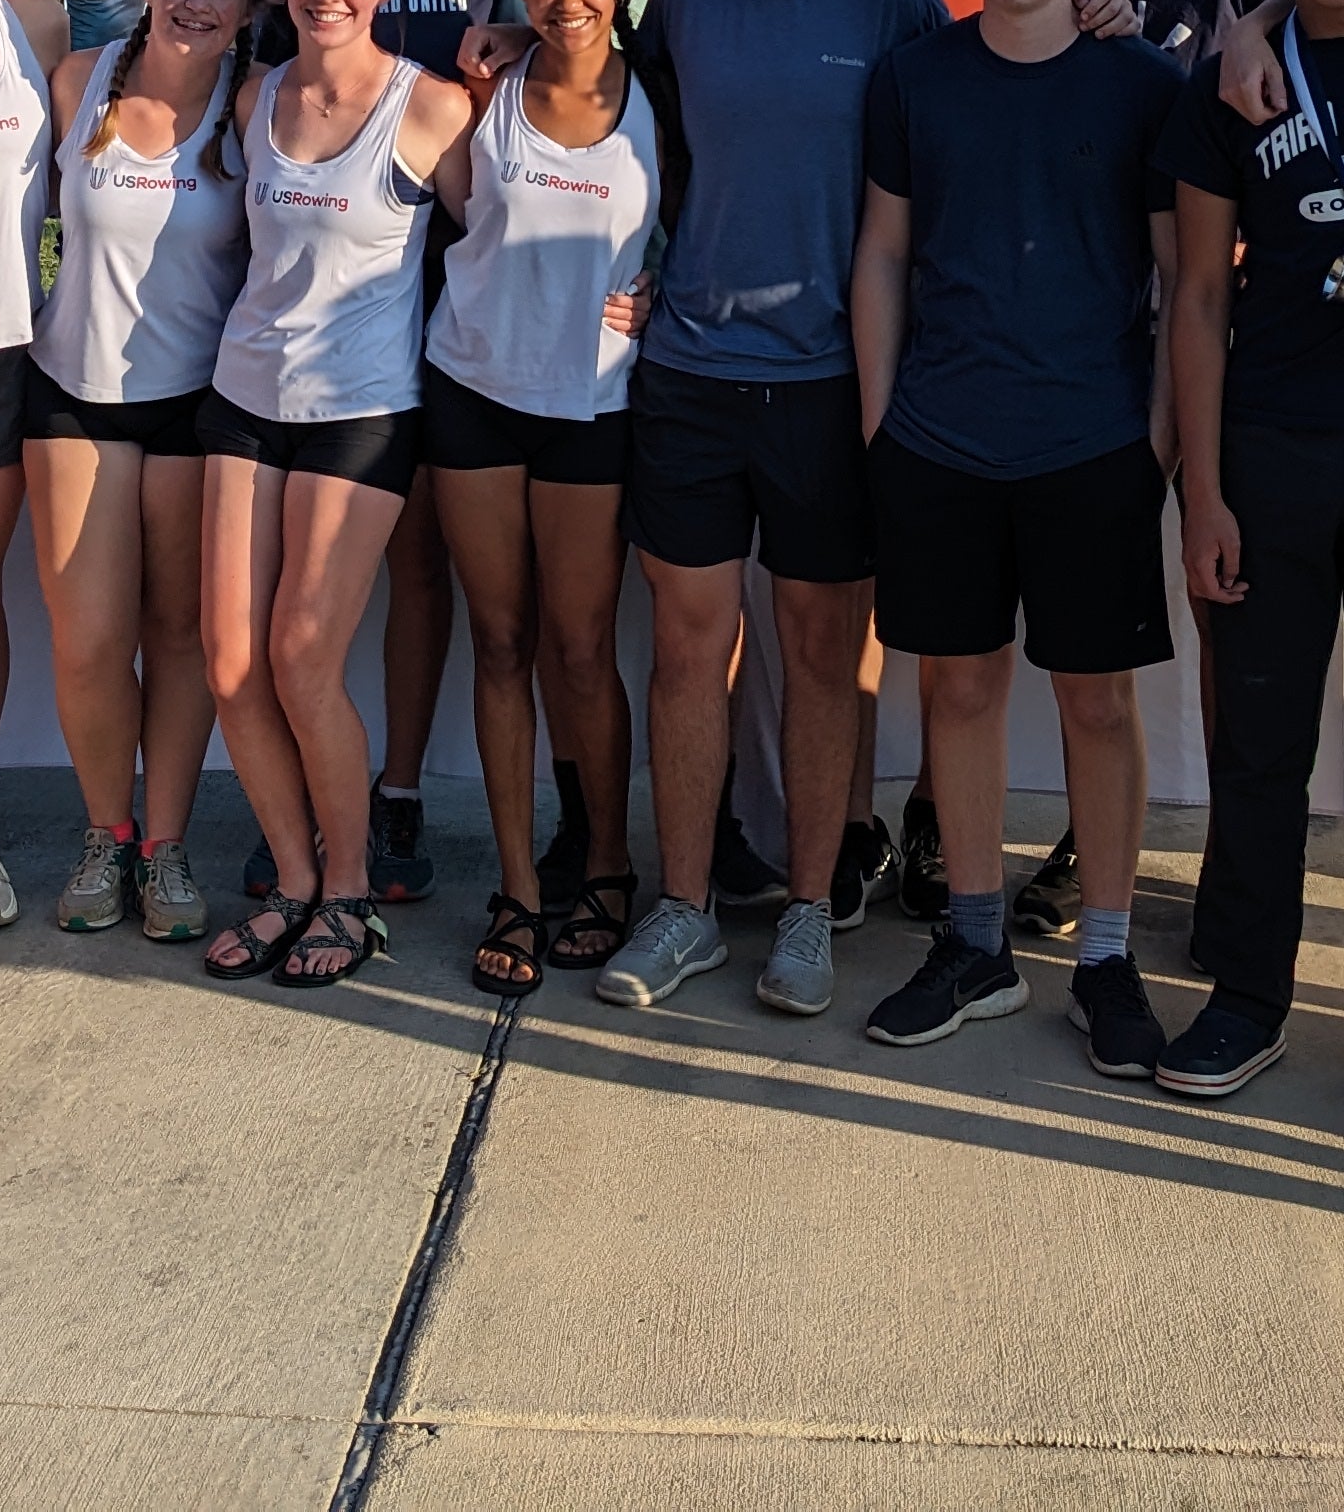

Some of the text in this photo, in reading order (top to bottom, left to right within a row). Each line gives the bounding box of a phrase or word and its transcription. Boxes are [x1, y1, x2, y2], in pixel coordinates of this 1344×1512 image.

[113, 174, 197, 192] USRowing
[525, 170, 610, 199] USRowing
[272, 189, 349, 212] USRowing
